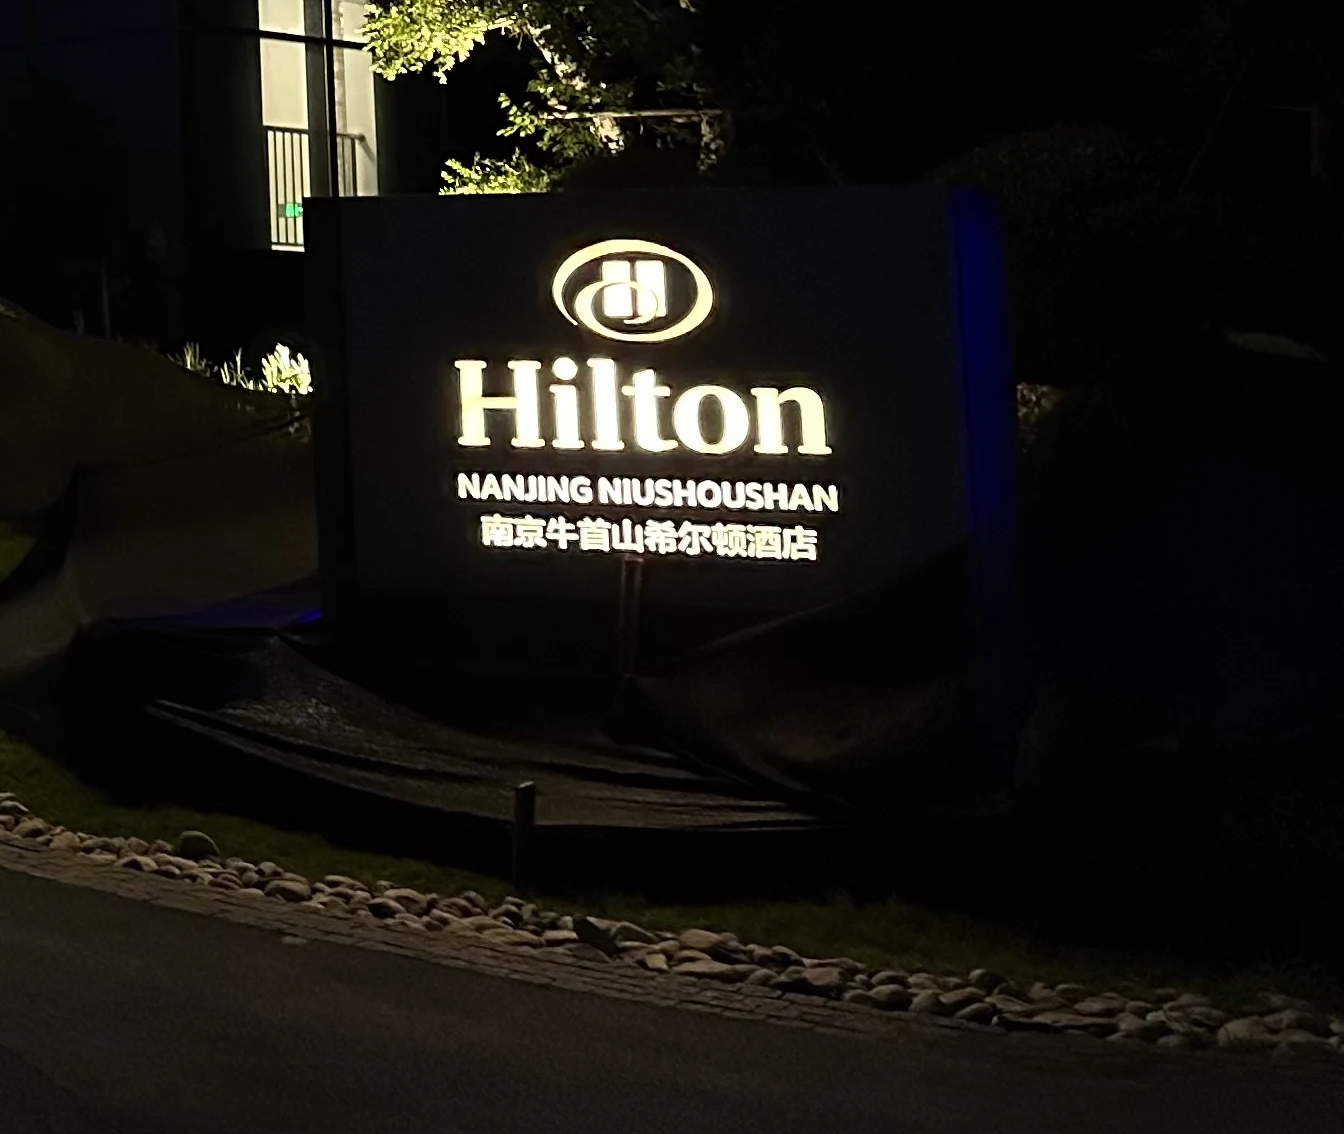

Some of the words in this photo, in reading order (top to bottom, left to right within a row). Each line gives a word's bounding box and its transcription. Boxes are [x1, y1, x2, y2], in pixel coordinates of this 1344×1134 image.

[454, 356, 832, 455] Hilton
[456, 472, 593, 505] NANJING
[597, 476, 840, 513] NIUSHOUSHAN
[479, 513, 818, 562] 南京牛首山希尔顿酒店
